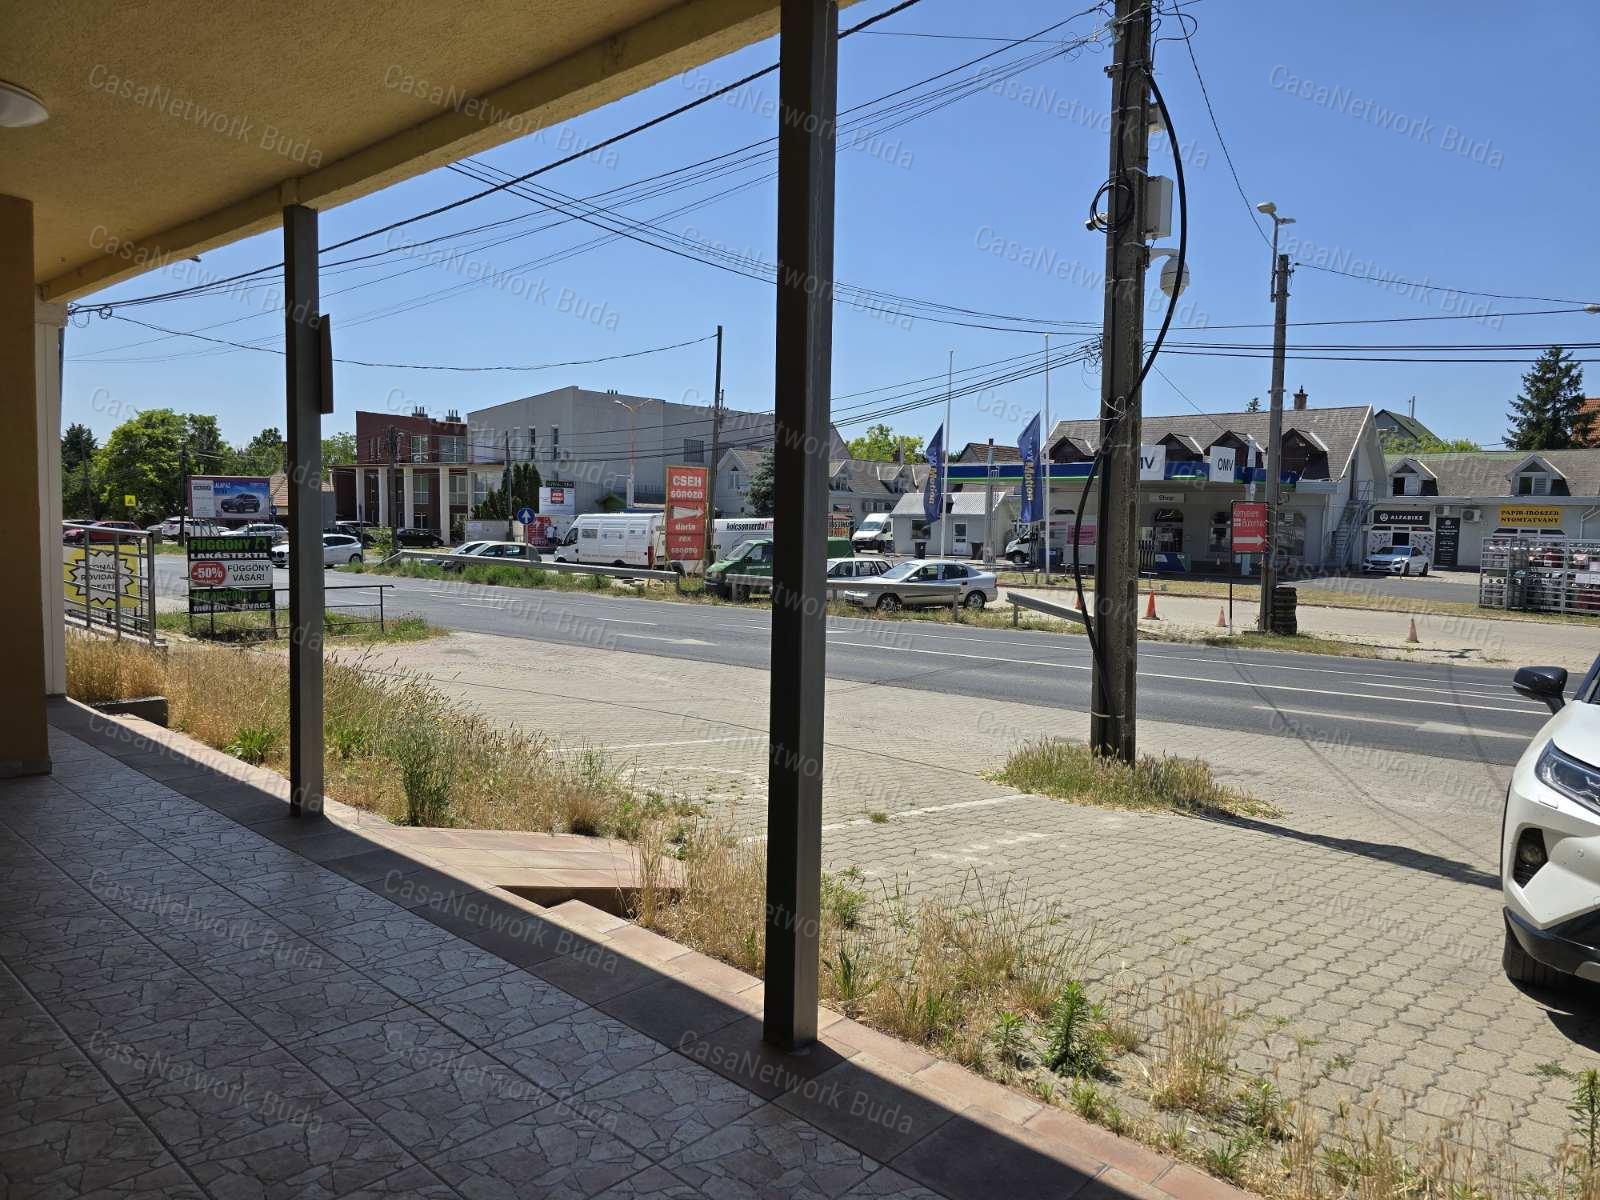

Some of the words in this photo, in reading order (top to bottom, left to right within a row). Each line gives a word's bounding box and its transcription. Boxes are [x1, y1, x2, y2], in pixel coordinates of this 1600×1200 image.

[1217, 457, 1233, 472] OMV
[672, 475, 702, 487] CSEH
[193, 567, 223, 578] -50%
[227, 563, 270, 572] FÜGGÖNY
